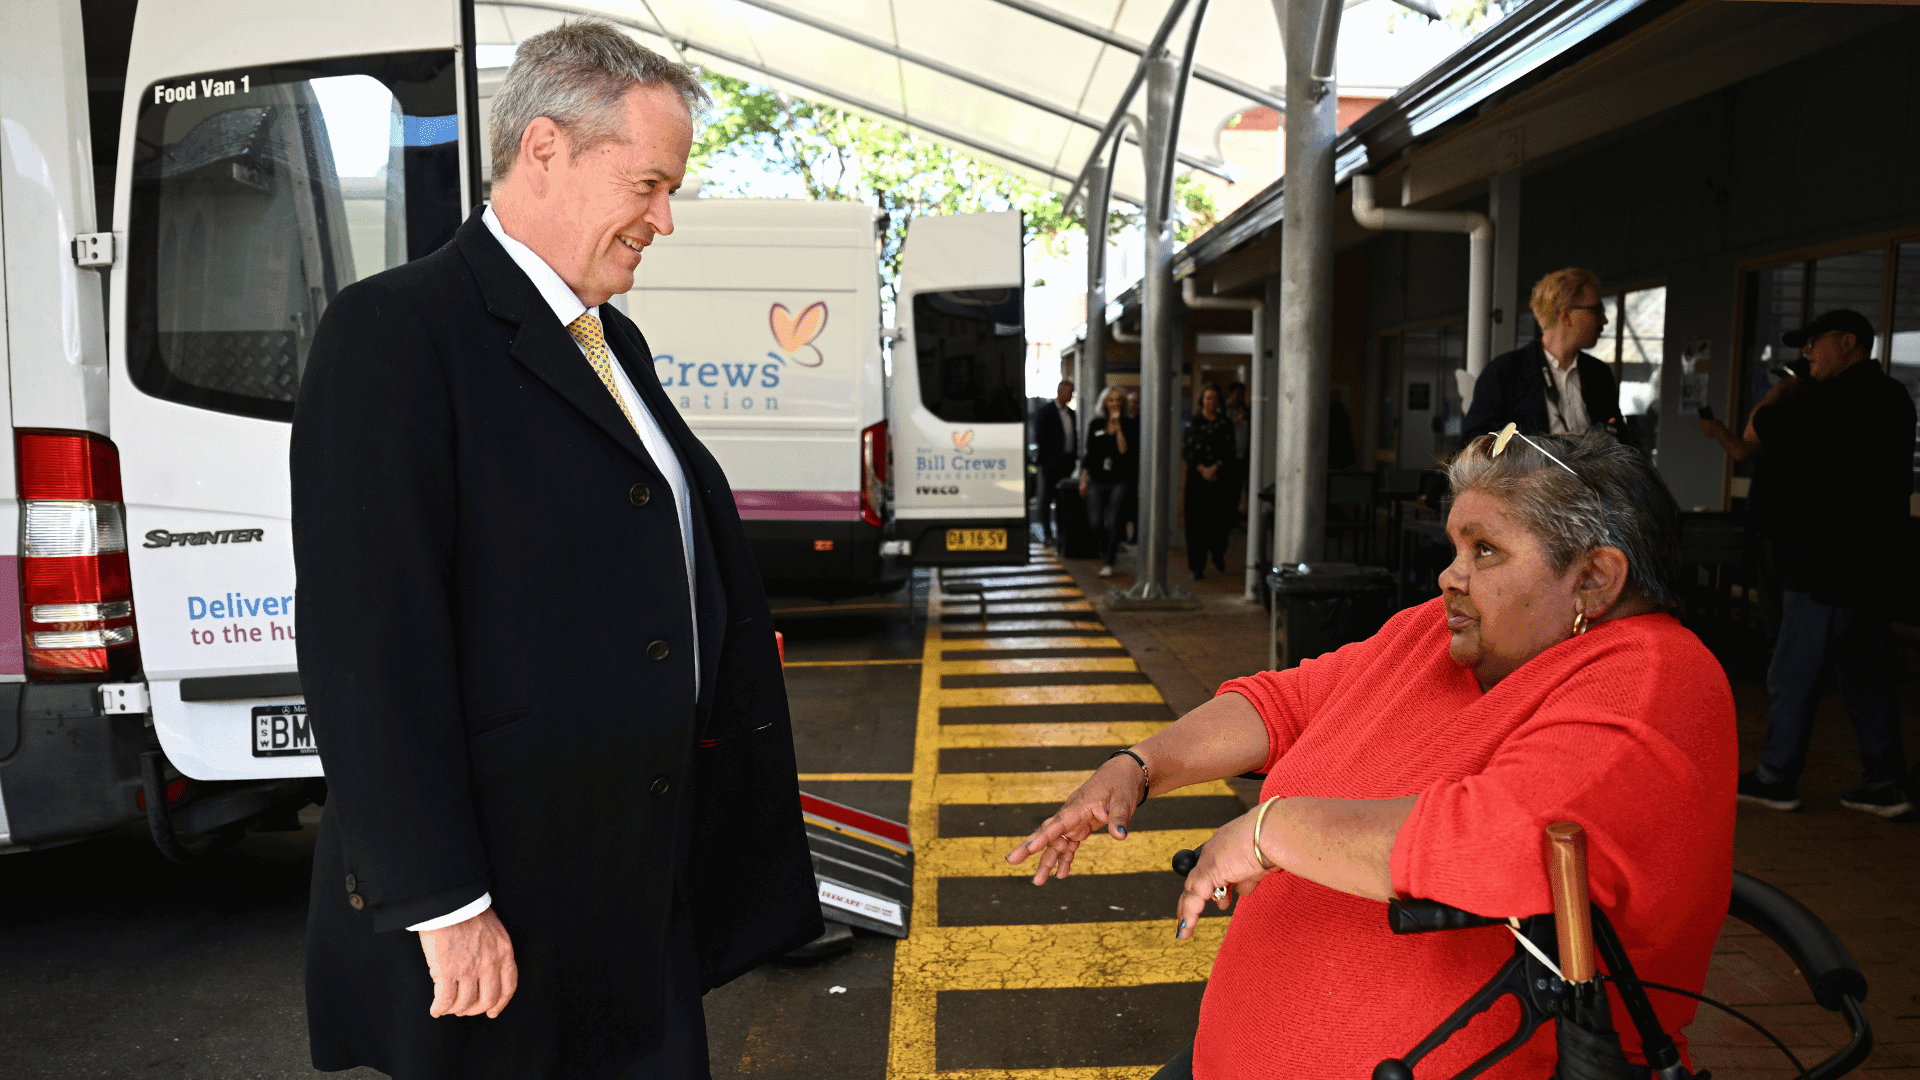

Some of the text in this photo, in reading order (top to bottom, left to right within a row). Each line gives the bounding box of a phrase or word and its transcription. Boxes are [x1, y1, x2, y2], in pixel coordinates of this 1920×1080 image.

[155, 75, 250, 104] Food Van 1
[917, 455, 1007, 471] Bill Crews
[916, 485, 960, 495] IVECO
[188, 592, 293, 620] Deliver
[191, 628, 215, 645] to
[222, 623, 262, 643] the
